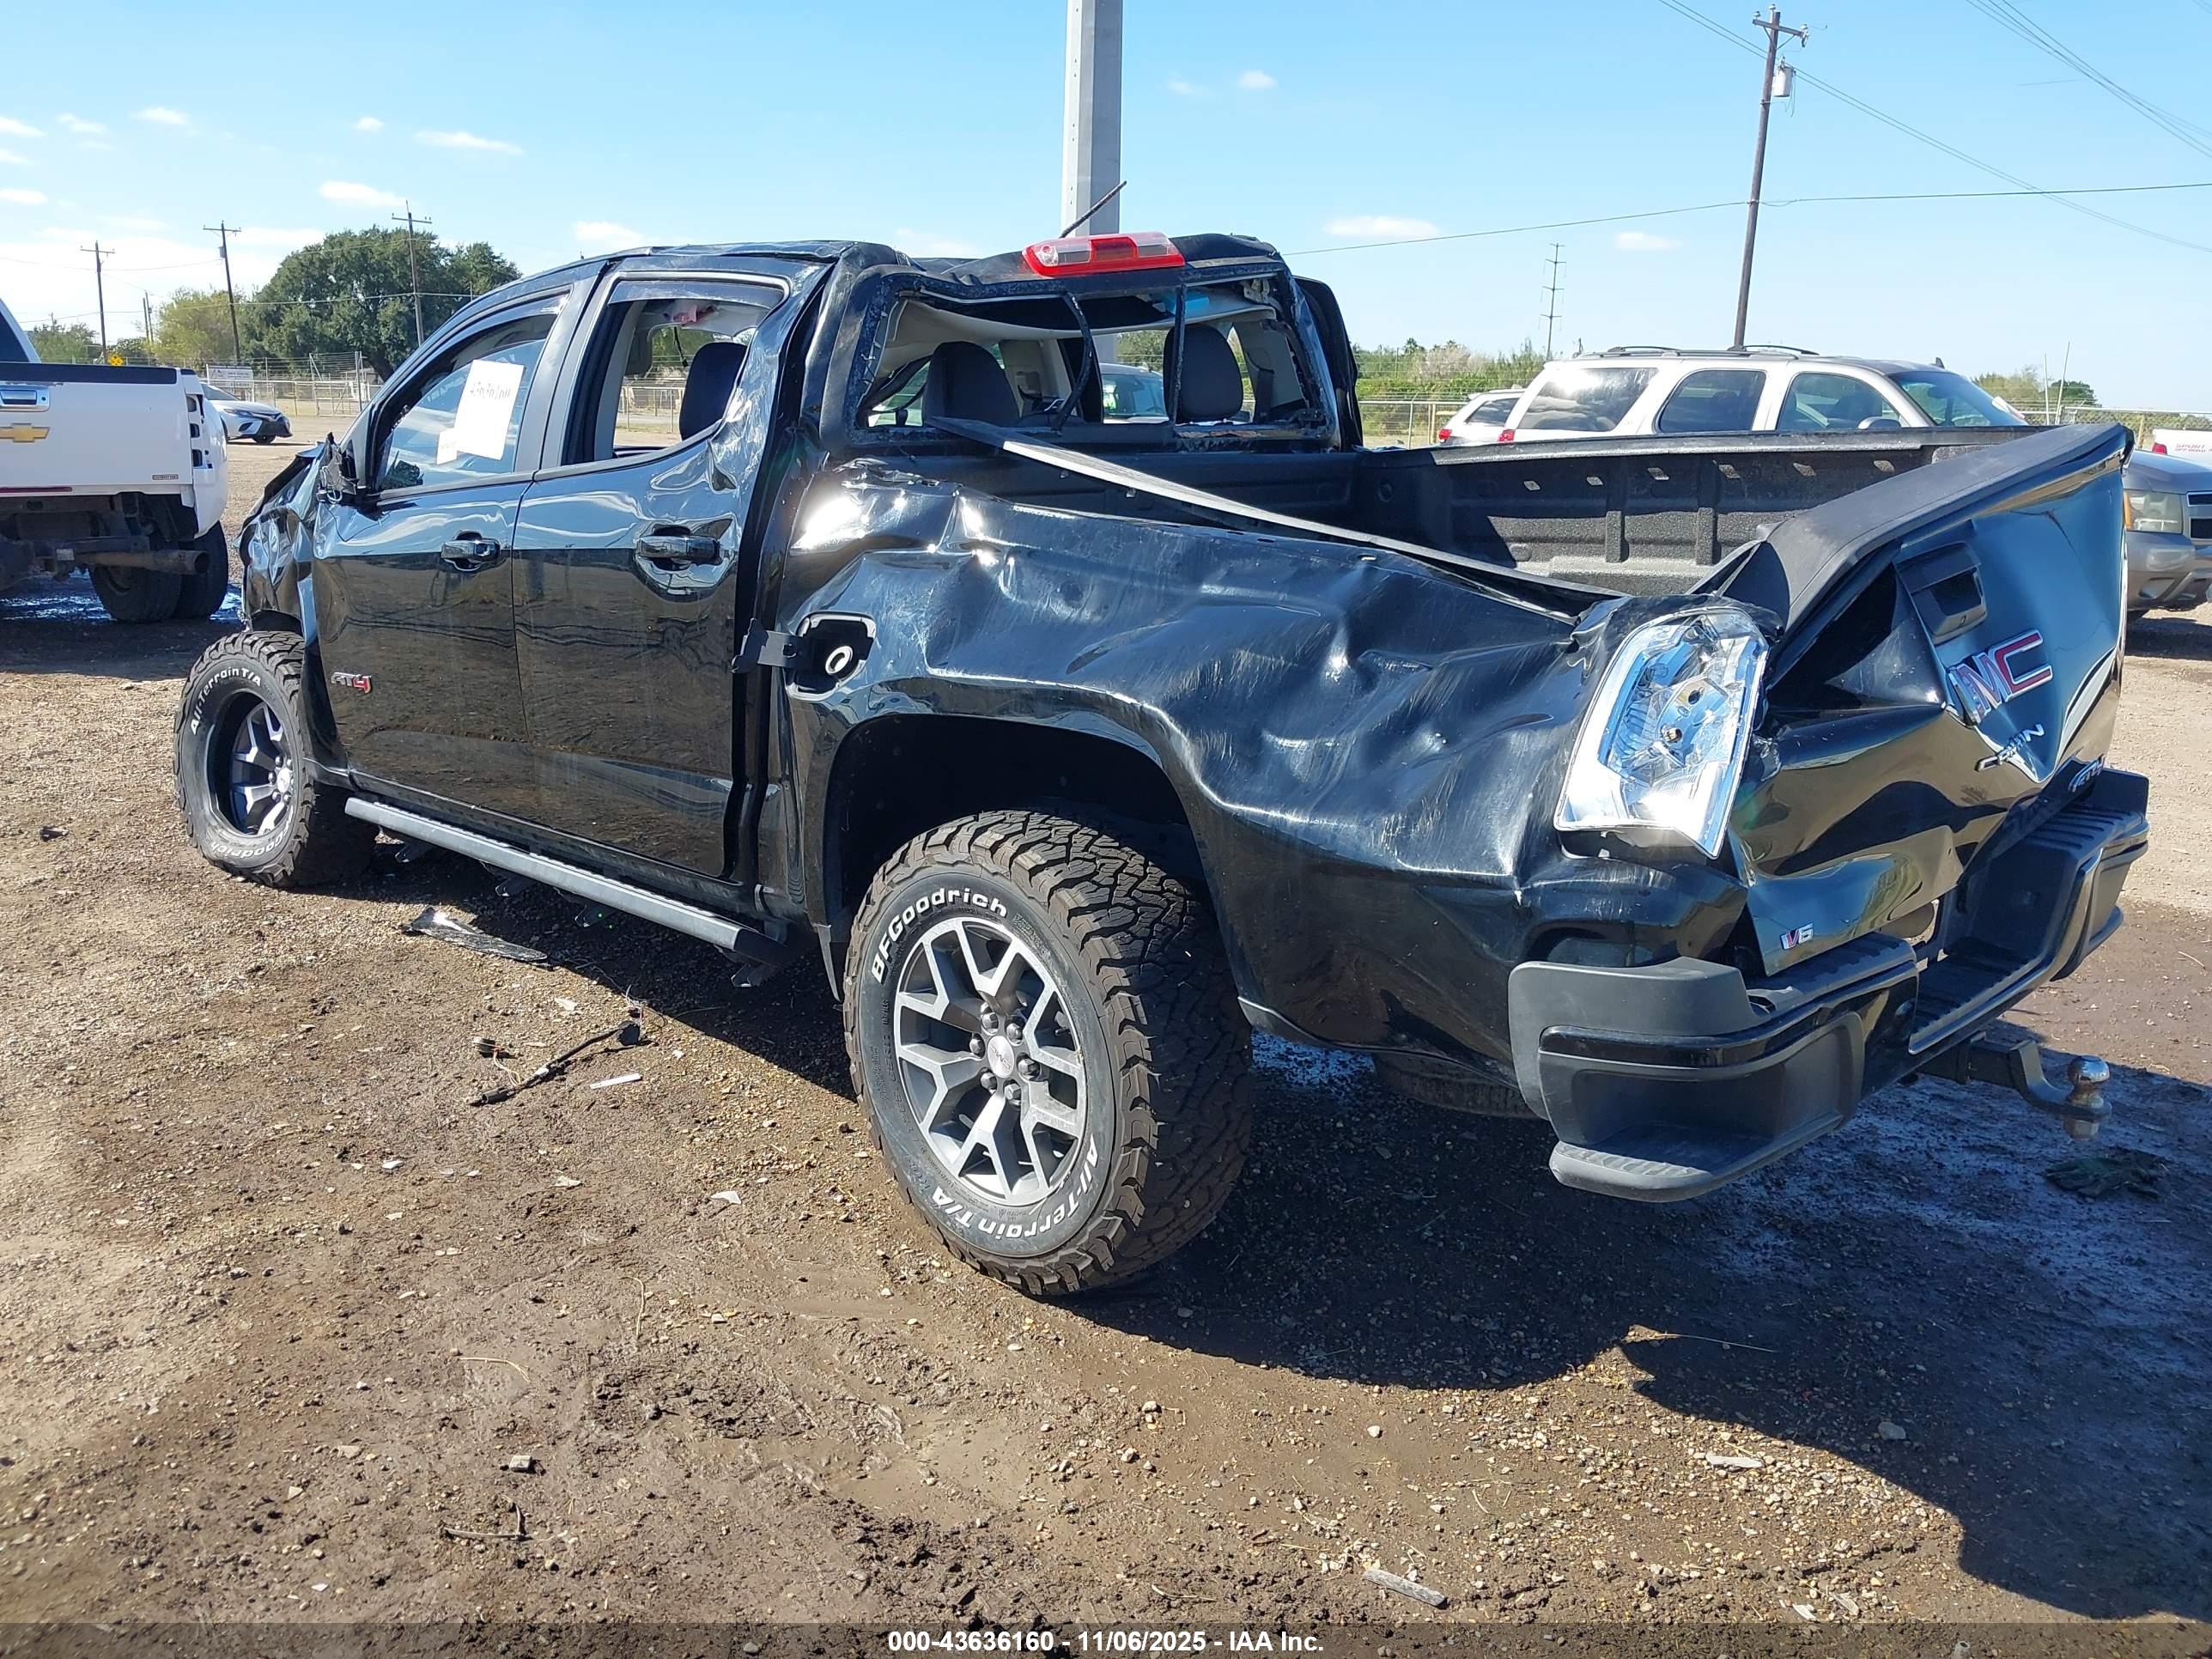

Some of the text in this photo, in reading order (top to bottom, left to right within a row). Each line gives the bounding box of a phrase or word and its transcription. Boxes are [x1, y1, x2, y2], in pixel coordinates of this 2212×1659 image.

[191, 666, 262, 736] All-Terrain T/A
[872, 888, 1008, 983] BFGoodrich
[1780, 923, 1814, 950] V6
[932, 1185, 976, 1229] T/A
[976, 1133, 1099, 1240] All-Terrain
